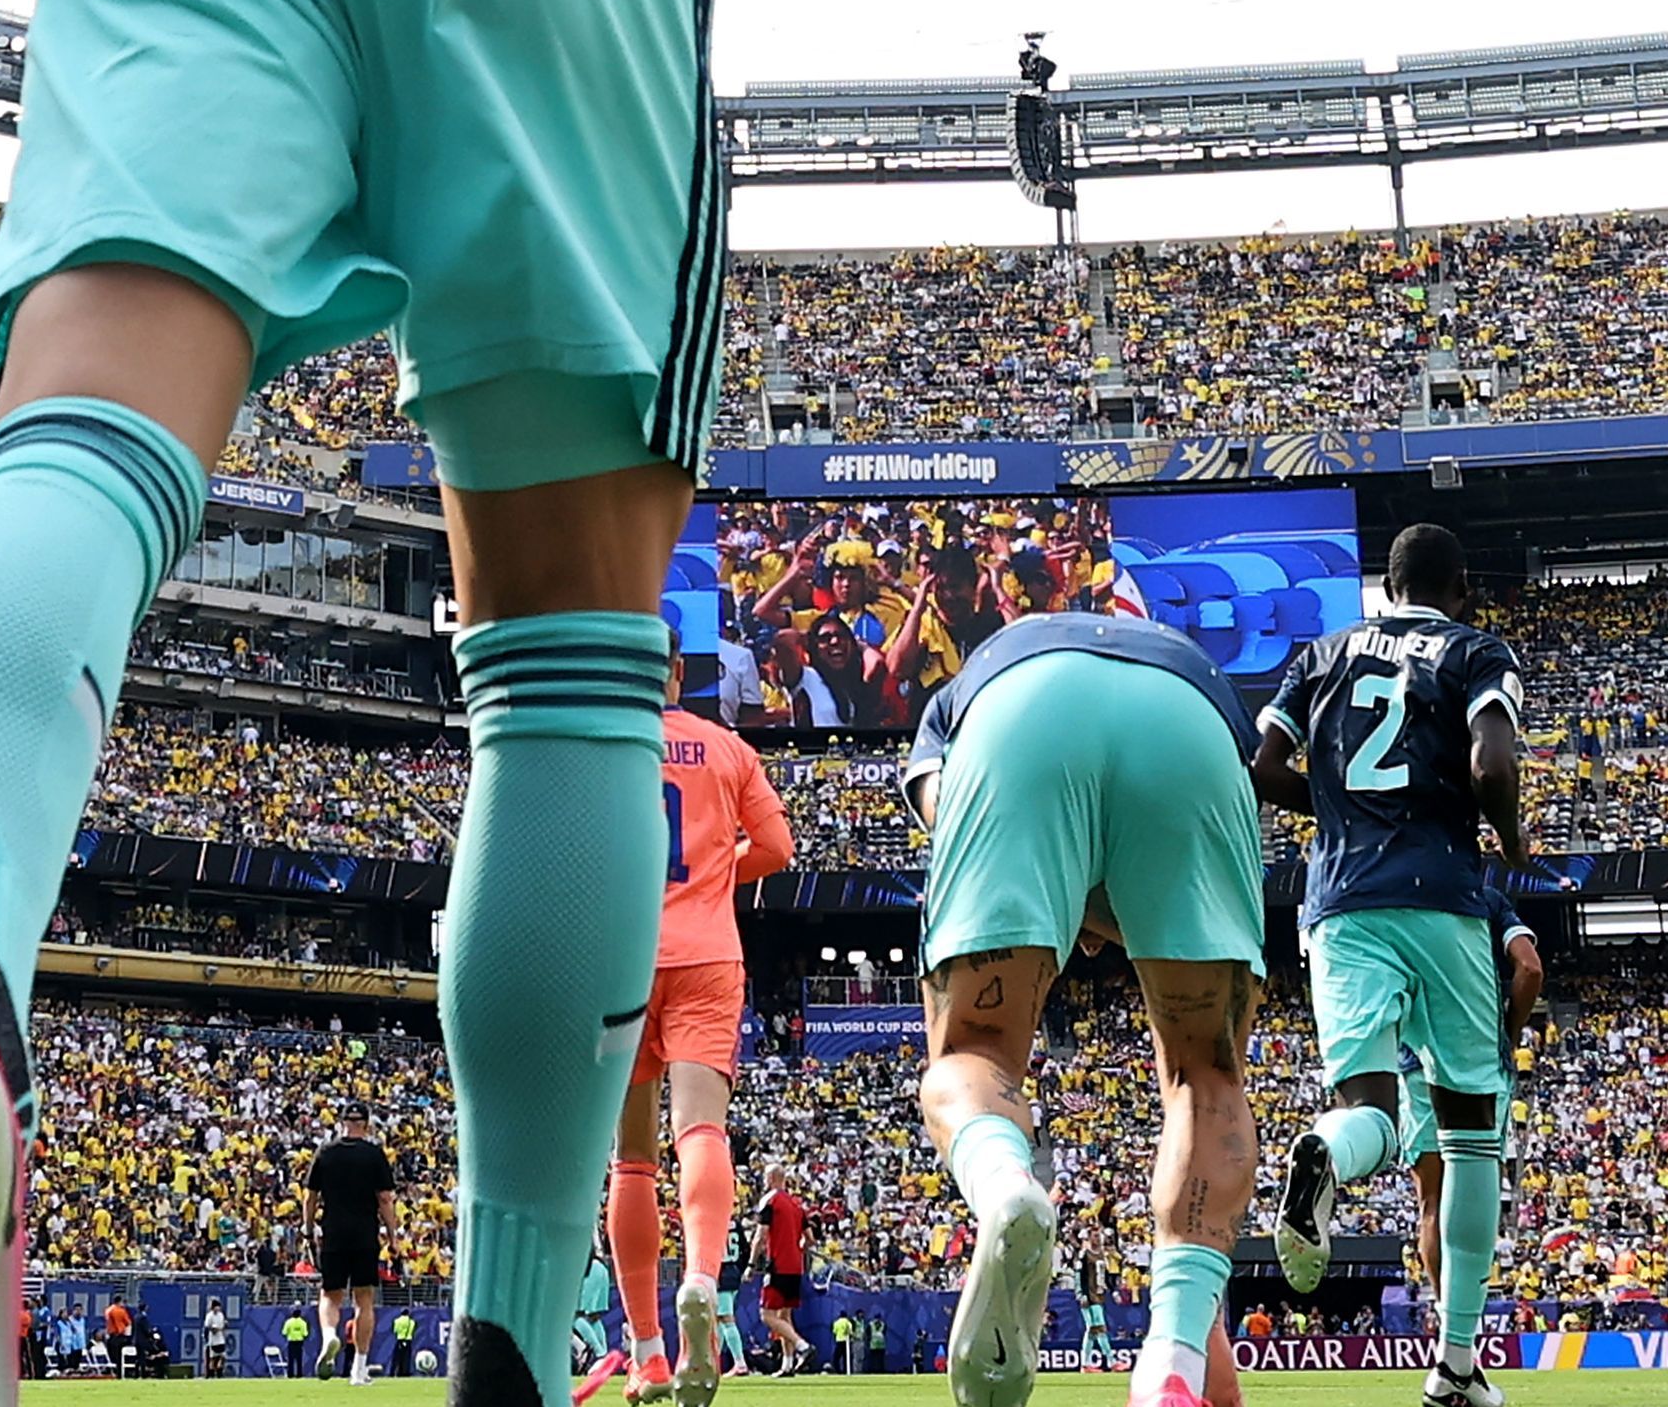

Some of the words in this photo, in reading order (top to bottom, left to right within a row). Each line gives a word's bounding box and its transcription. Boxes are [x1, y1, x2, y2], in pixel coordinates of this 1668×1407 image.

[823, 452, 997, 485] #FIFAWorldCup
[212, 481, 294, 508] JERSEY
[1346, 673, 1410, 792] 2
[806, 1022, 833, 1033] FIFA
[832, 1022, 876, 1033] WORLD
[876, 1022, 901, 1033] CUP
[902, 1021, 928, 1033] 20
[1233, 1339, 1346, 1371] QATAR
[1361, 1335, 1507, 1369] AIRWYS
